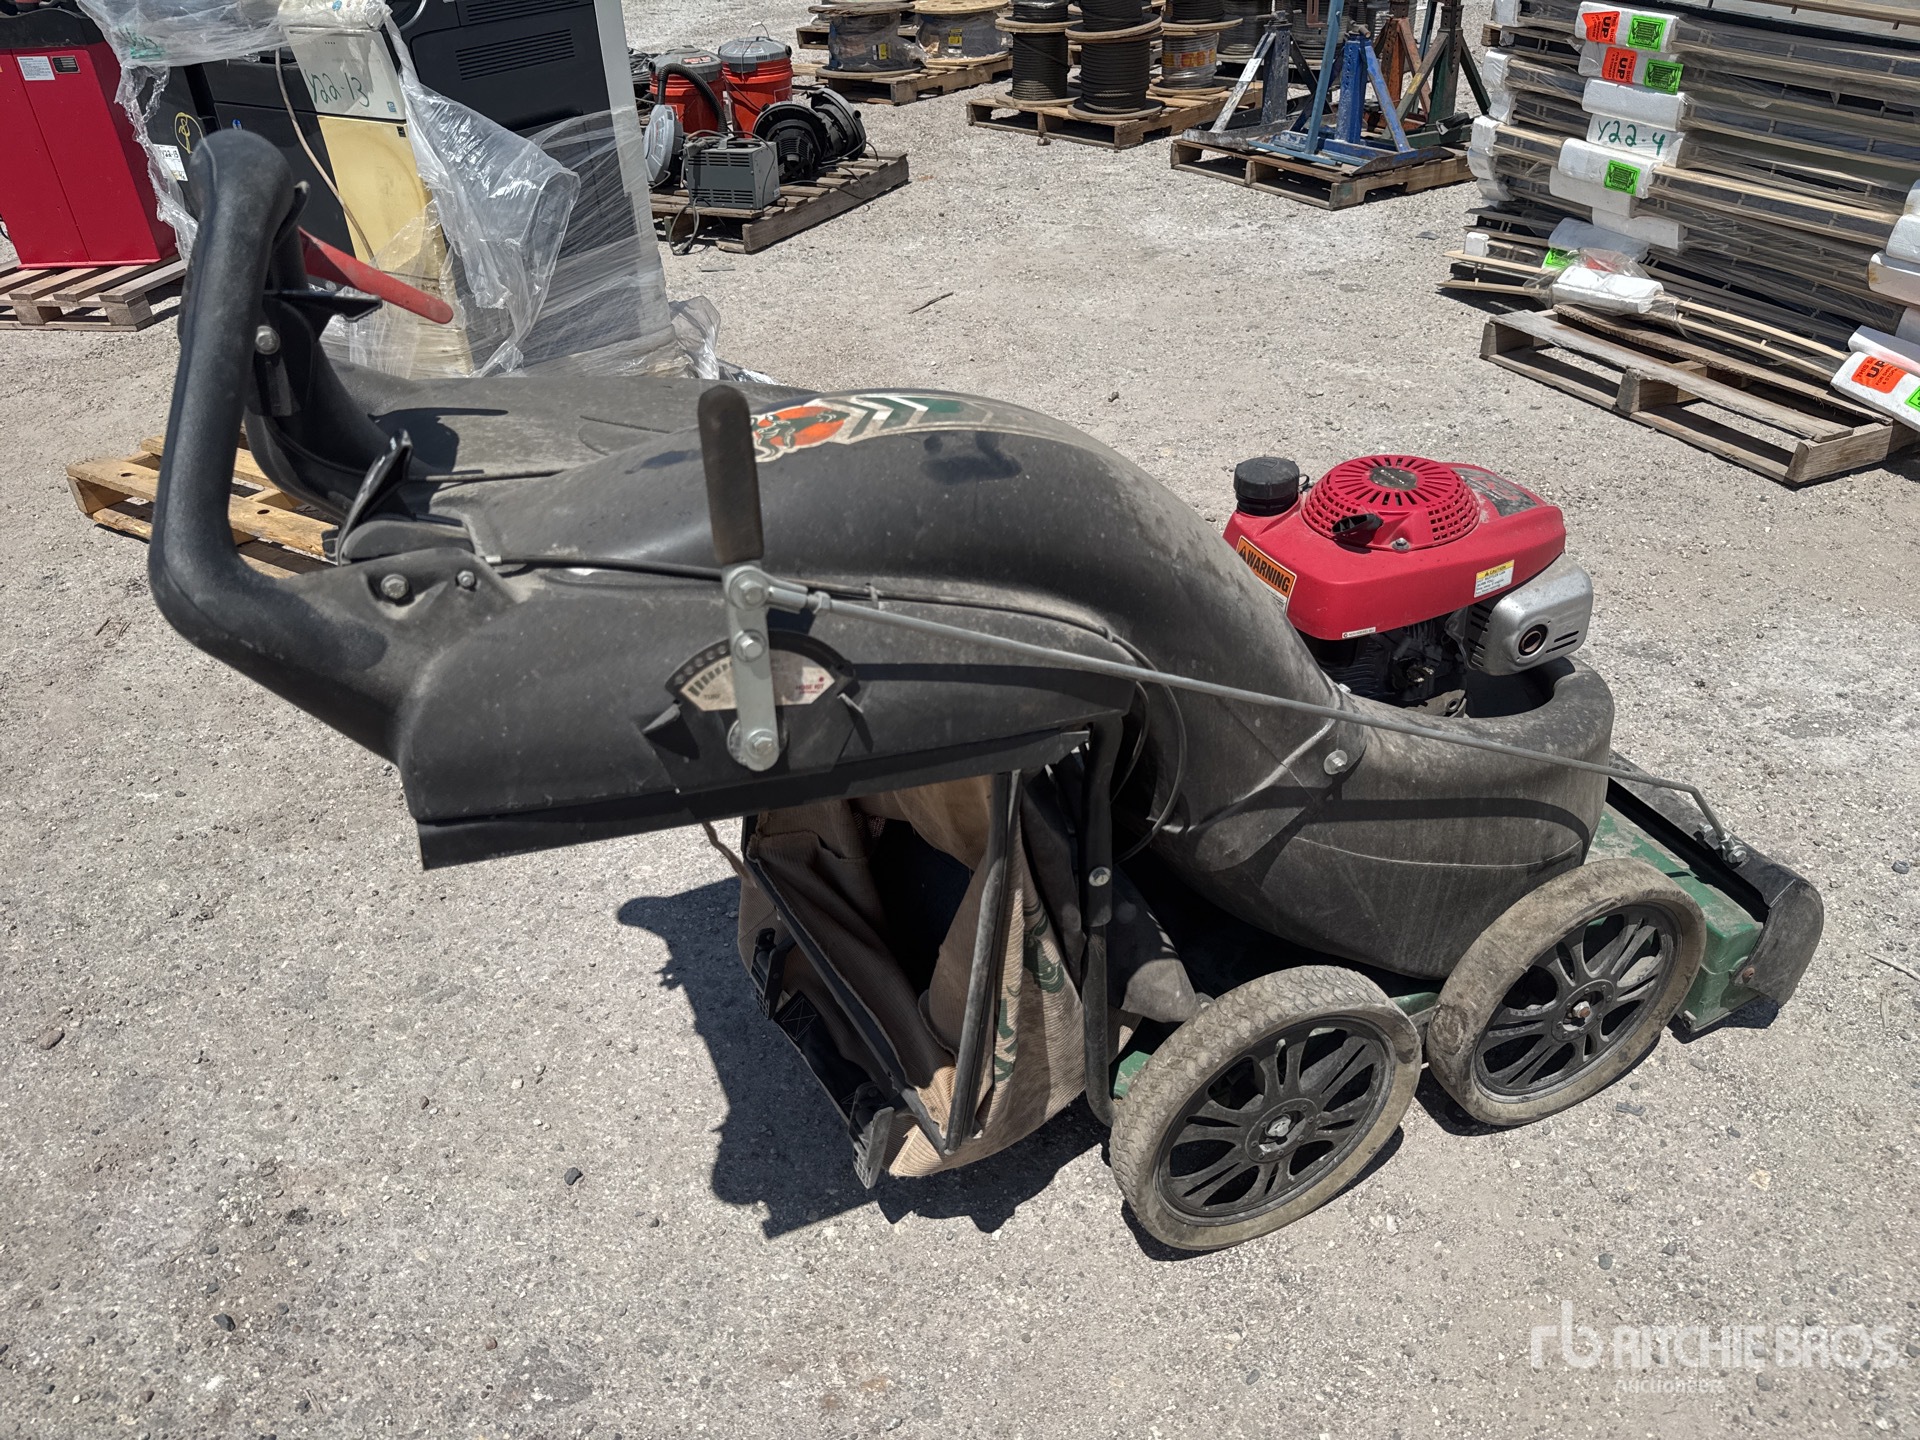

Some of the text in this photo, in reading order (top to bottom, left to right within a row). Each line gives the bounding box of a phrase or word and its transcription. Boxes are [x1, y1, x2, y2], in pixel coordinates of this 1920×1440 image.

[1602, 16, 1611, 38] UP
[1617, 57, 1628, 79] UP
[1598, 120, 1665, 156] Y22-4
[1856, 363, 1869, 378] THIS
[1866, 359, 1886, 378] UP
[1246, 549, 1290, 593] WARNING
